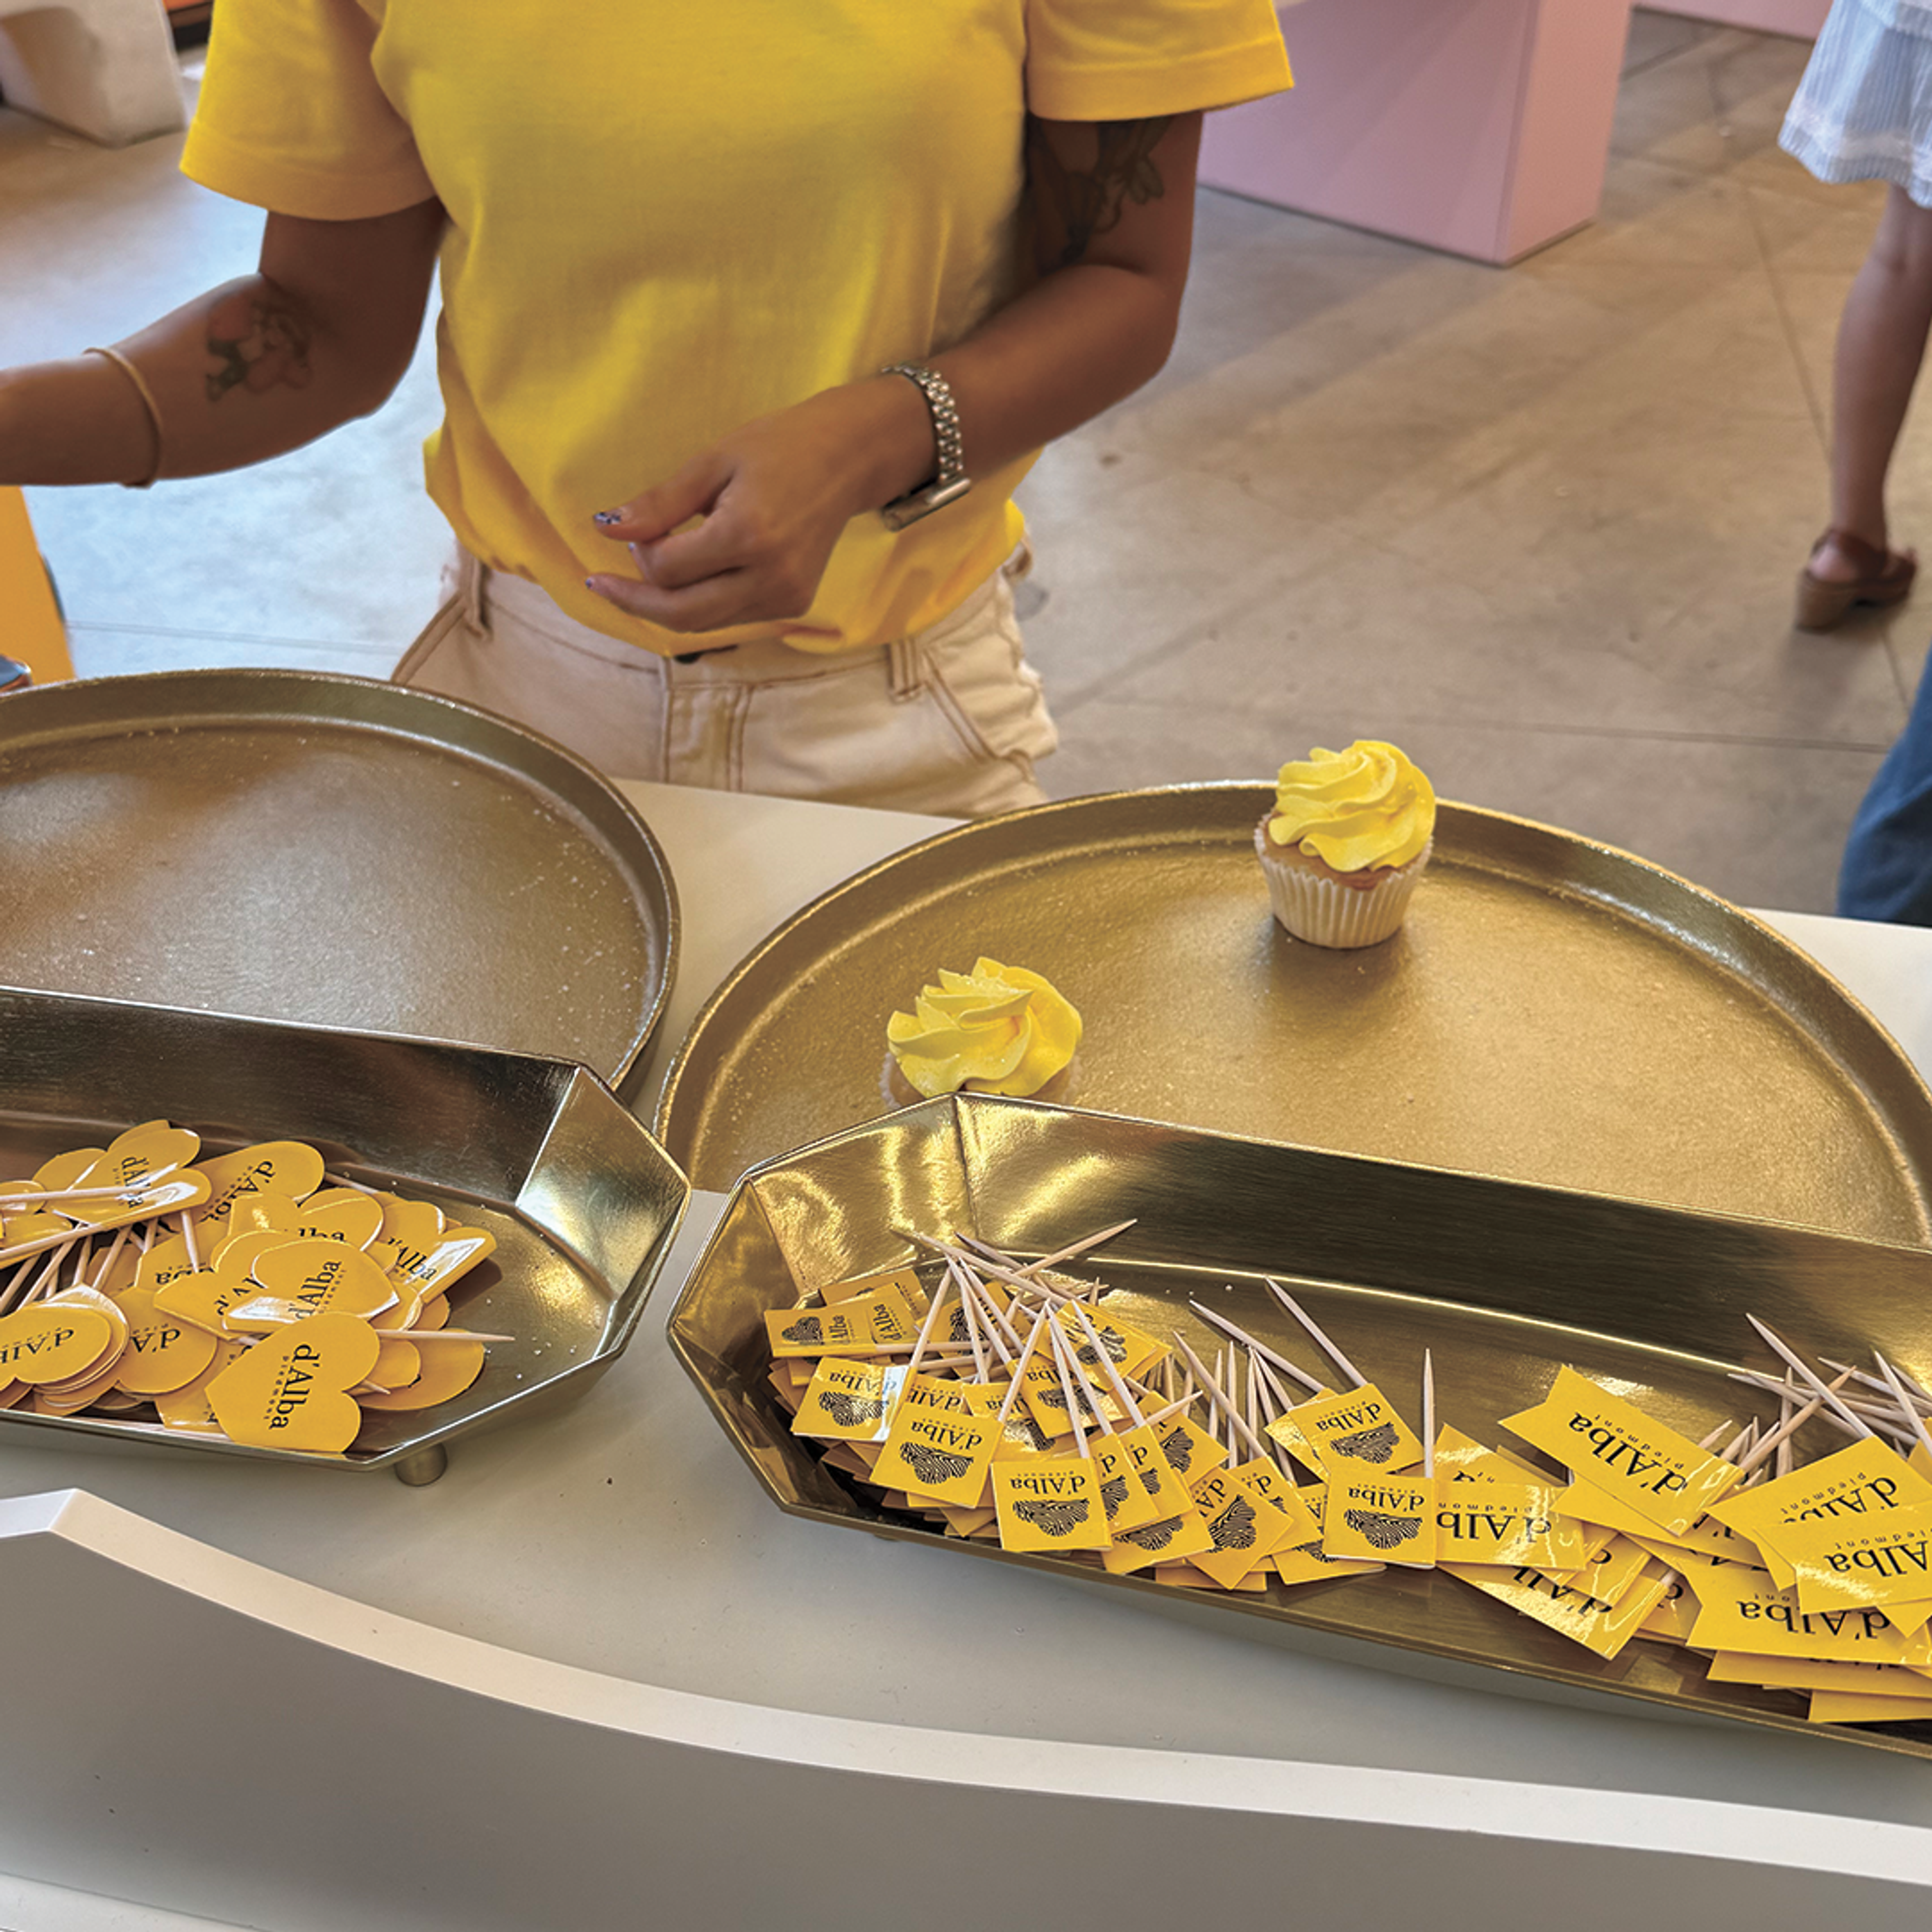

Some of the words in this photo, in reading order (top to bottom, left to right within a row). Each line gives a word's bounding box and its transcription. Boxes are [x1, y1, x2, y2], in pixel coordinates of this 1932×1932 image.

[269, 1344, 320, 1429] d'Alba
[1315, 1402, 1381, 1432] d'Alba
[911, 1420, 982, 1451] d'Alba
[1594, 1414, 1684, 1470] piedmont
[1569, 1410, 1688, 1495] d'Alba
[1010, 1475, 1086, 1495] d'Alba
[1348, 1487, 1425, 1512] d'Alba
[1781, 1472, 1866, 1514] piedmont
[1438, 1502, 1533, 1512] piedmon
[1436, 1511, 1552, 1544] d'Alb
[1835, 1527, 1932, 1550] iedmont
[1824, 1540, 1928, 1577] Alba
